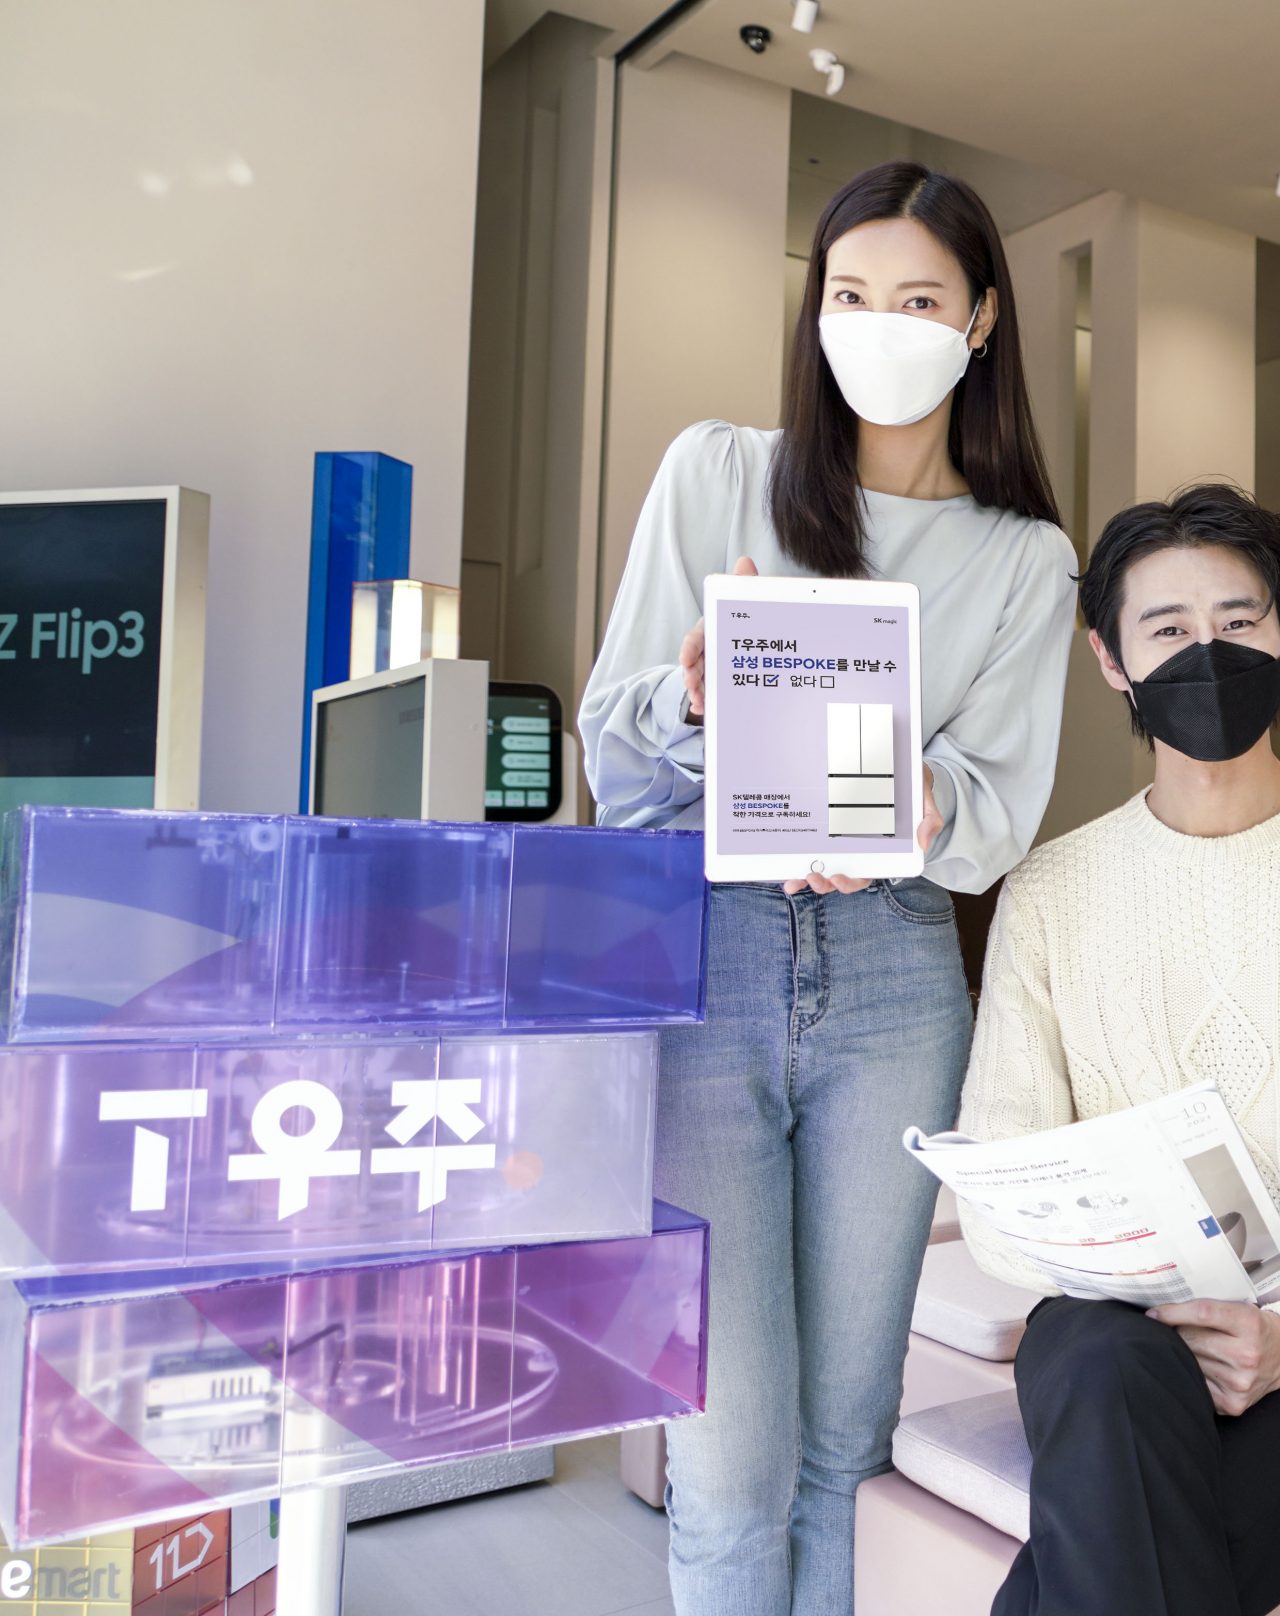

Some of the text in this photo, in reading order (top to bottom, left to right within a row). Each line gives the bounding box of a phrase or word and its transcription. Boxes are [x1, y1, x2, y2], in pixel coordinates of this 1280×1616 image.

[29, 607, 145, 675] Flip3
[731, 638, 797, 652] T우주에서
[731, 655, 897, 673] 삼성 BESPOKE를 만날 수
[732, 673, 817, 688] 있다 없다
[747, 802, 790, 810] BESPOKE를
[1, 1559, 121, 1600] emart
